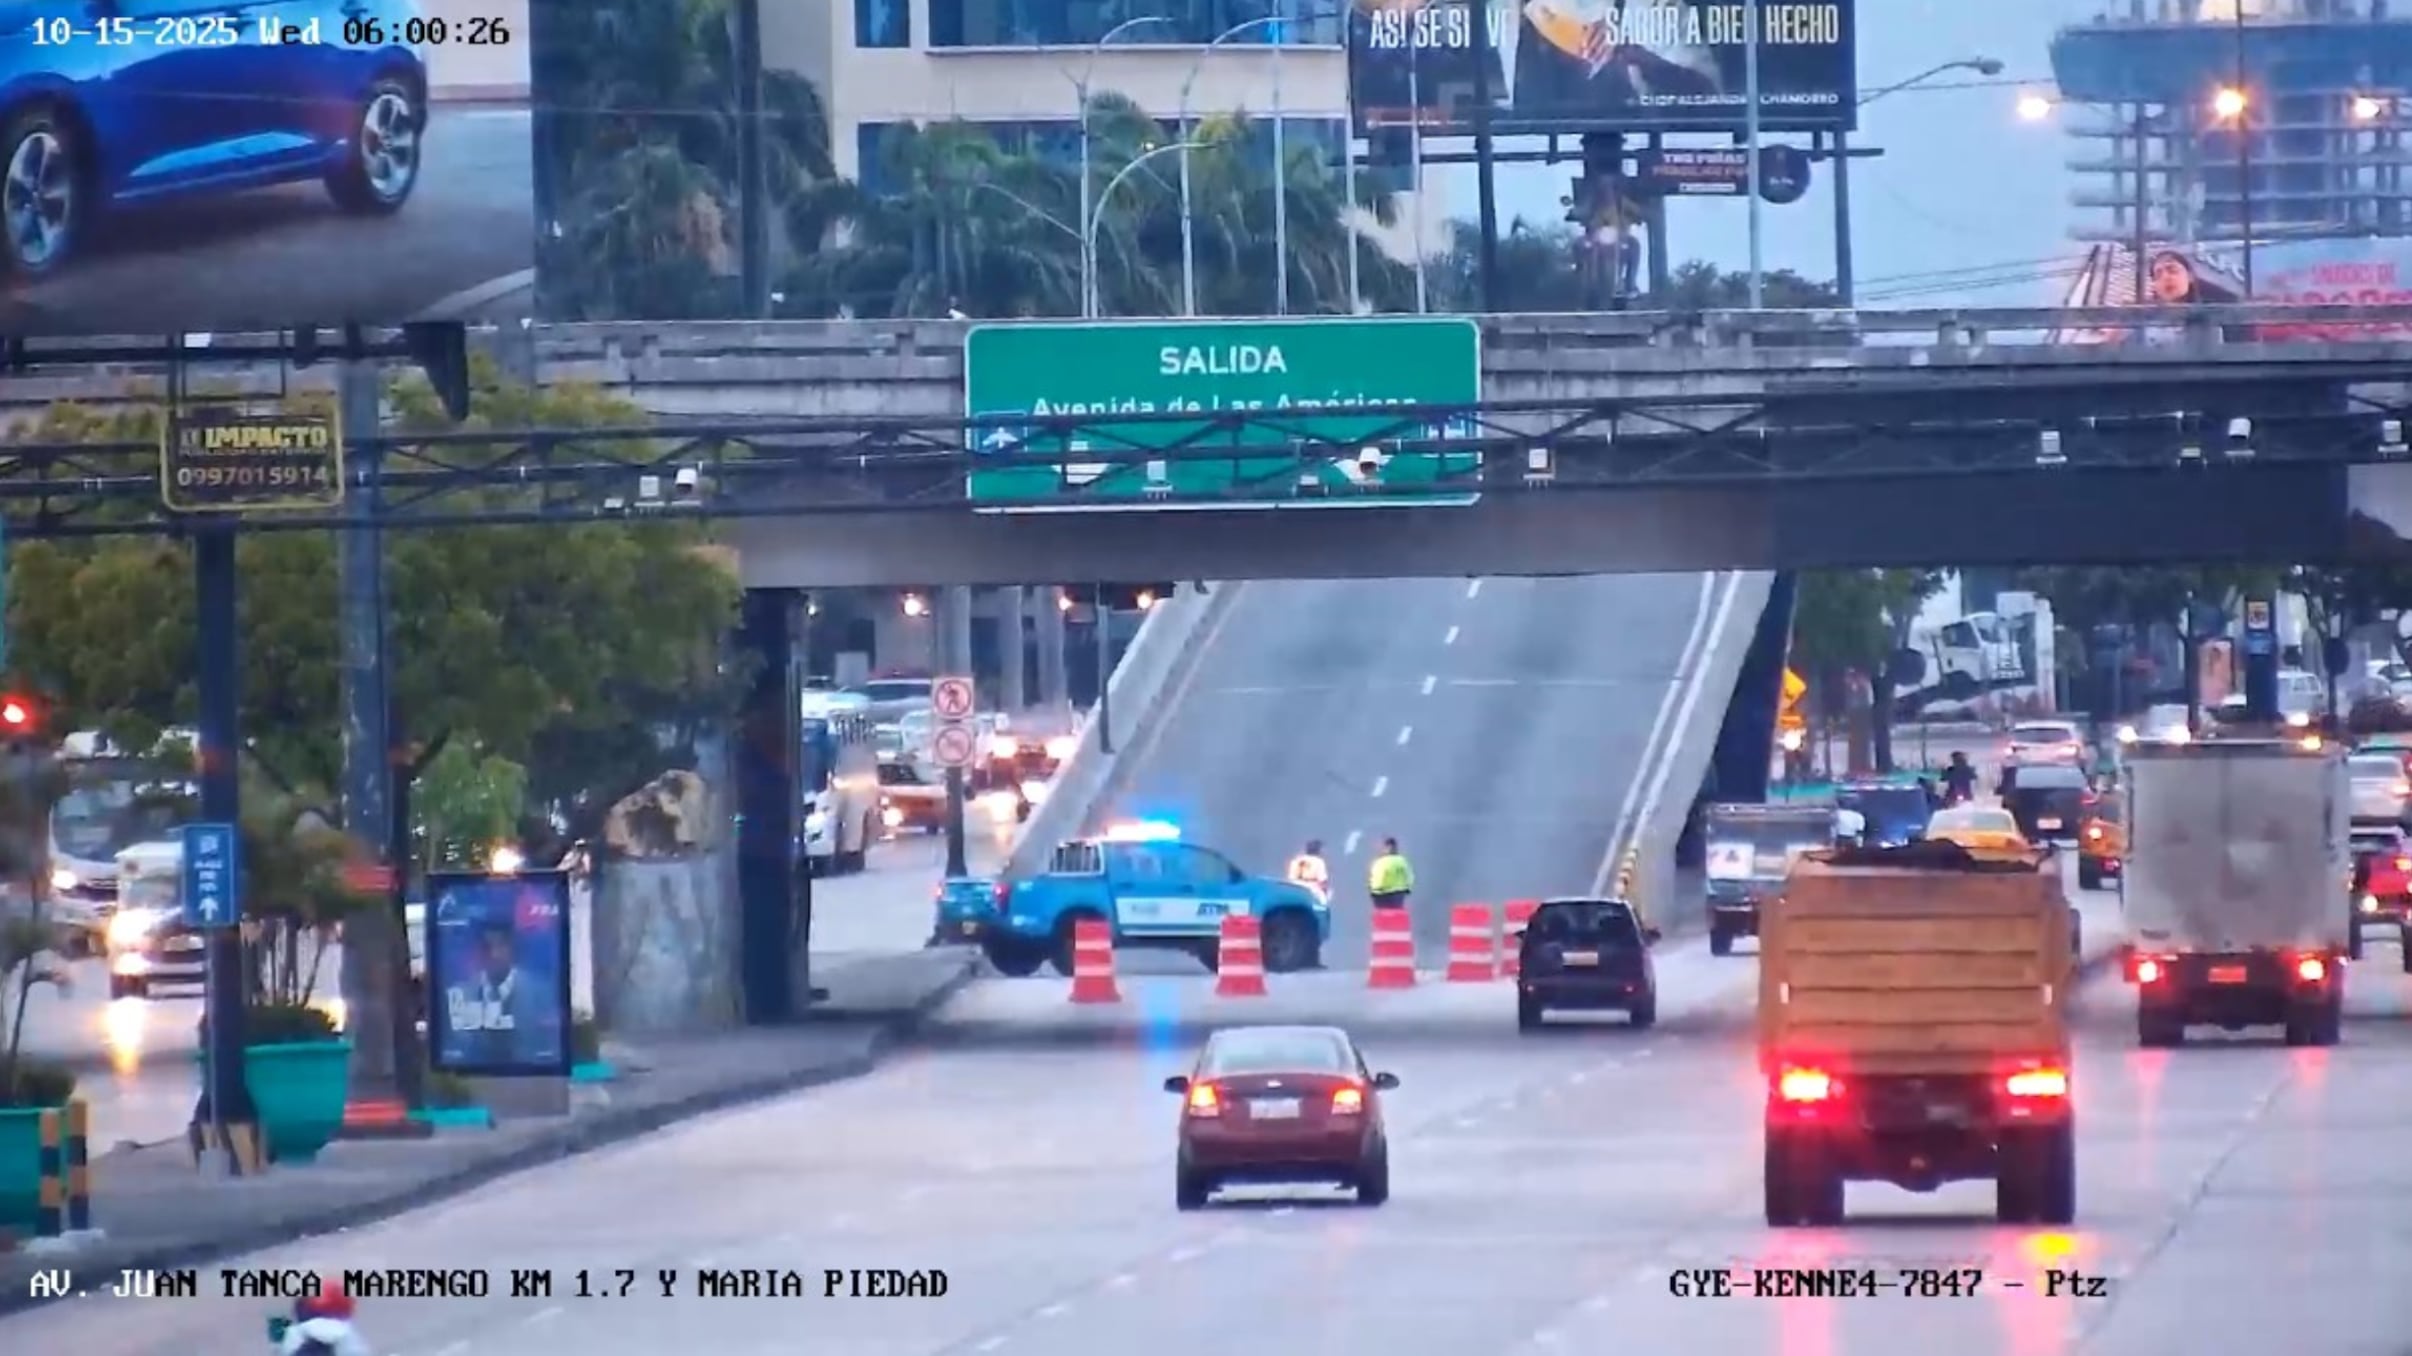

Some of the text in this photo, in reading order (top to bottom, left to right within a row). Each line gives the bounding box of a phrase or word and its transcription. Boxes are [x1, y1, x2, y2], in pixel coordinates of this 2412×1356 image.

[1414, 9, 1442, 48] SE
[1605, 6, 1679, 45] SABOR
[1686, 5, 1701, 45] A
[1766, 4, 1838, 44] HECHO
[1159, 345, 1288, 375] SALIDA
[1032, 396, 1155, 417] Avenida
[1167, 395, 1201, 413] de
[1212, 394, 1263, 411] Las
[205, 426, 328, 449] IMPACTO
[176, 466, 328, 487] 0997015914
